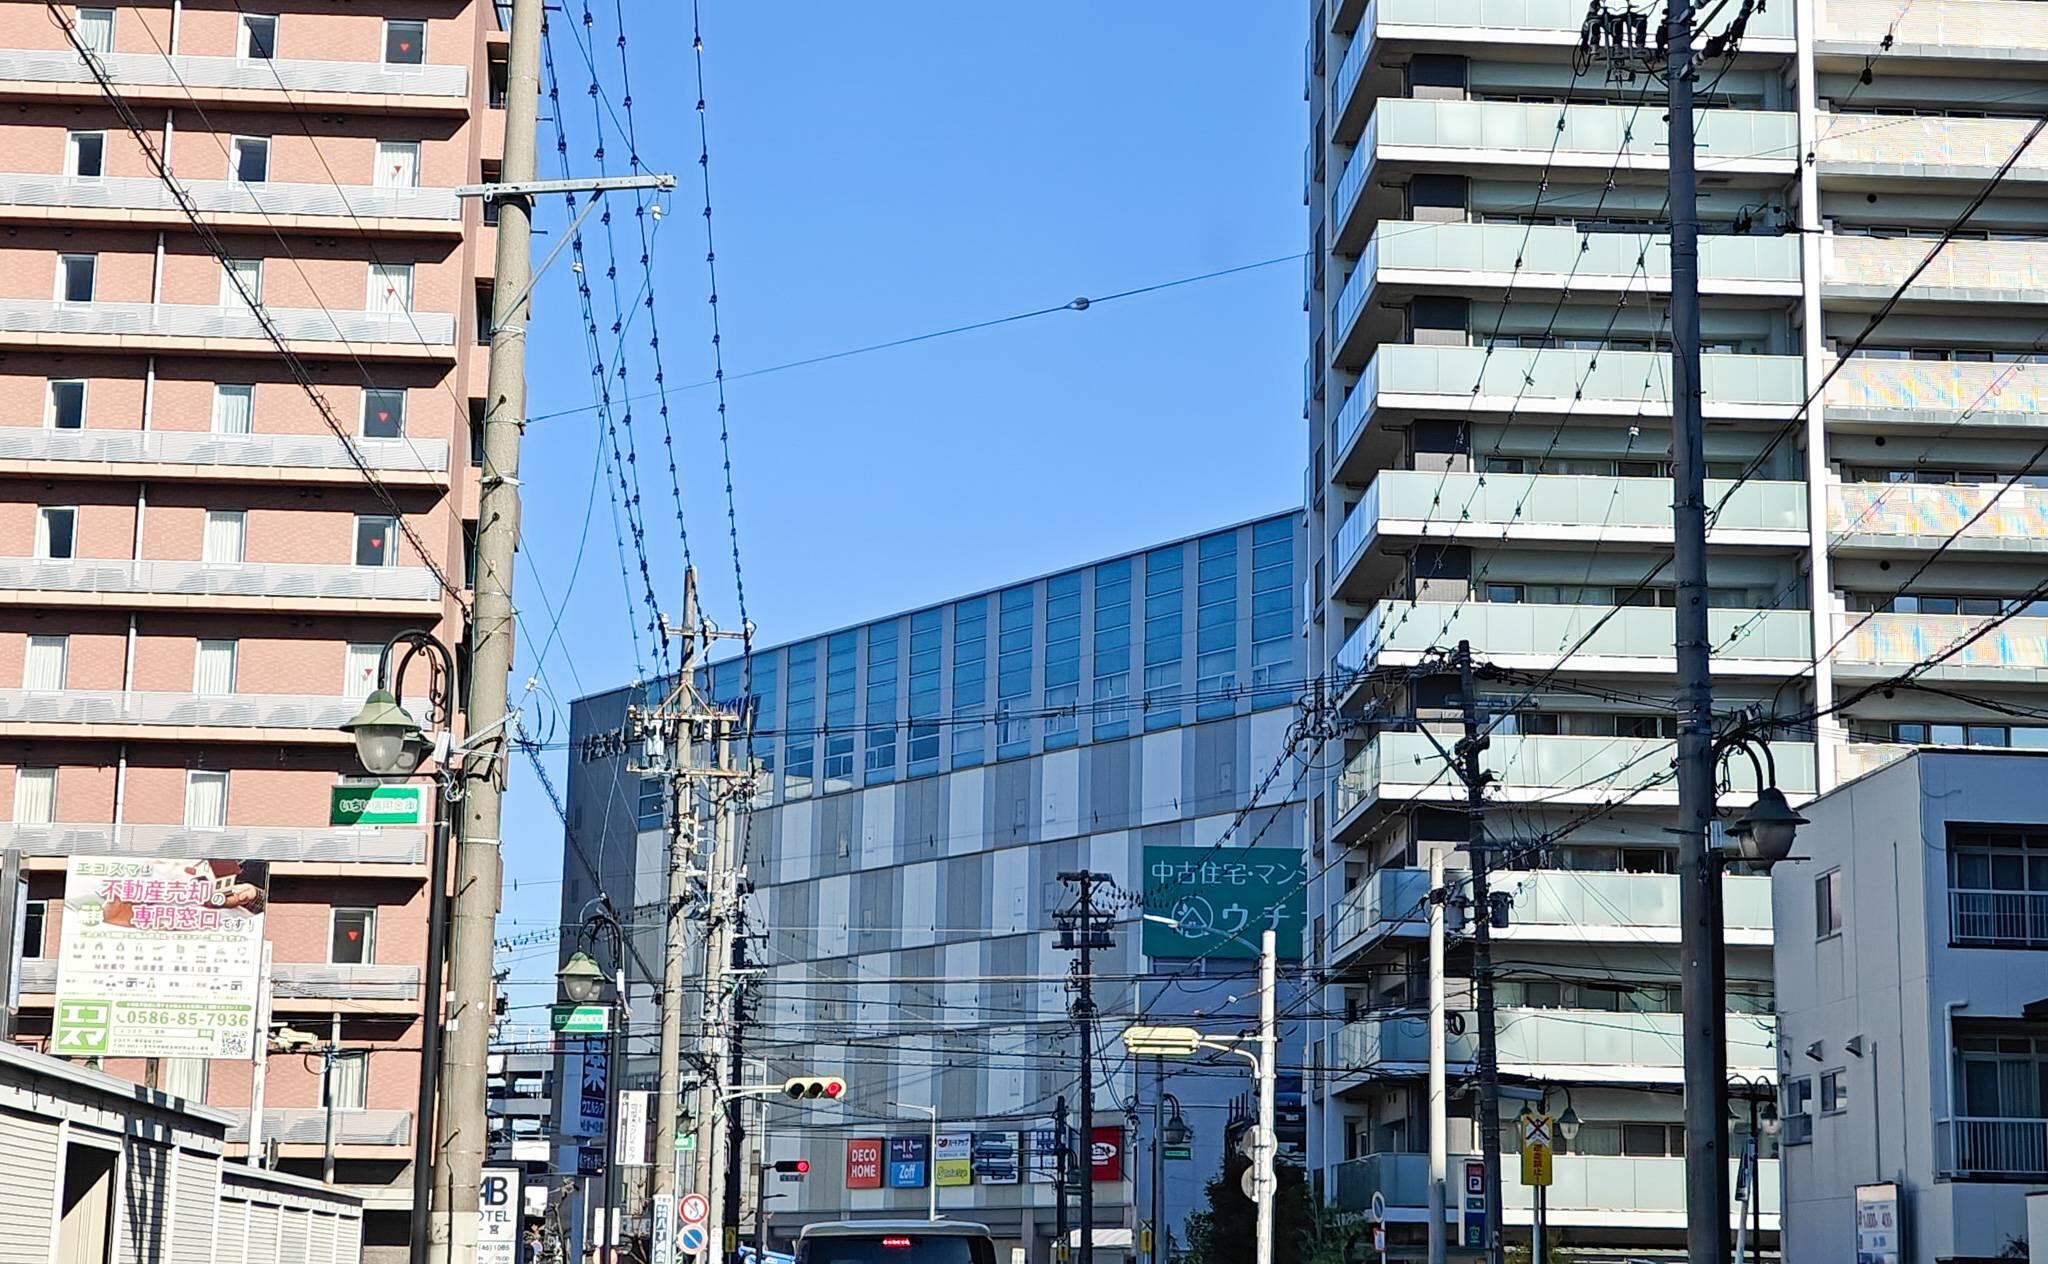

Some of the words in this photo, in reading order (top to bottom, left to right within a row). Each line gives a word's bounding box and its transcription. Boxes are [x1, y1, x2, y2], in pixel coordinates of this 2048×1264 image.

[76, 862, 152, 877] エコスマは
[101, 879, 225, 905] 不動産売却の
[126, 1010, 249, 1027] 0586-85-7936
[852, 1148, 877, 1162] DECO
[851, 1164, 876, 1178] HOME
[899, 1164, 916, 1179] Zoff
